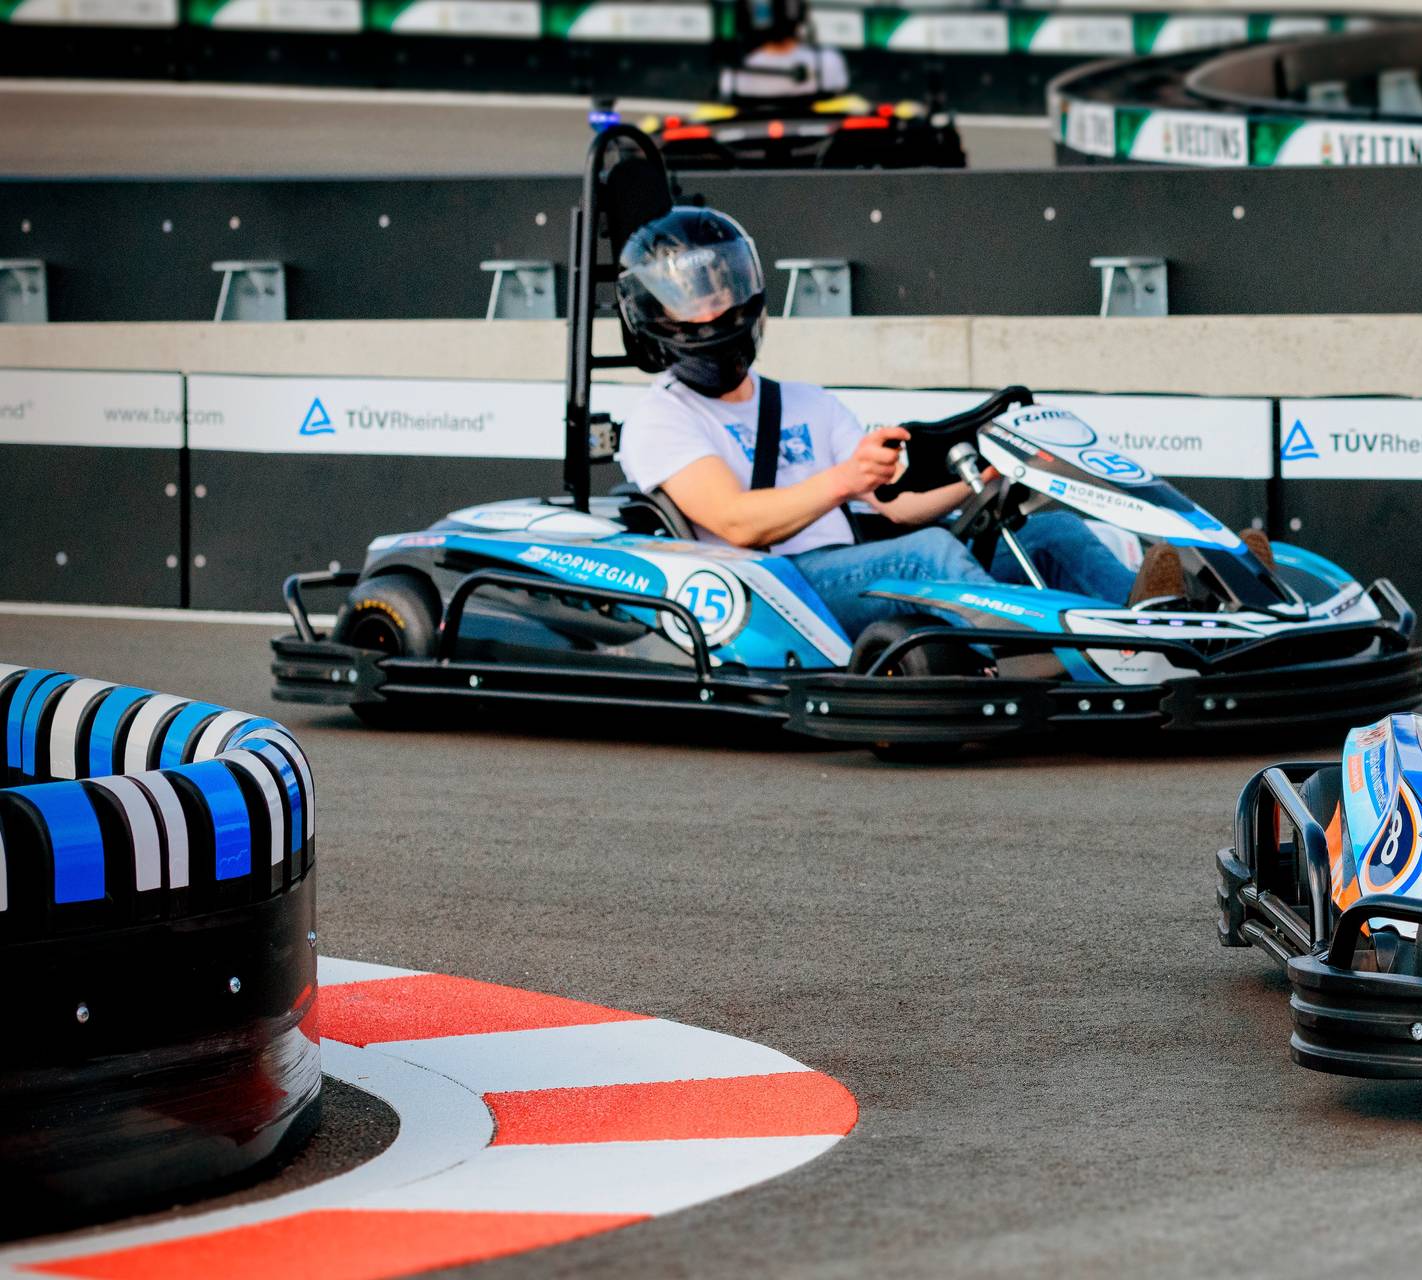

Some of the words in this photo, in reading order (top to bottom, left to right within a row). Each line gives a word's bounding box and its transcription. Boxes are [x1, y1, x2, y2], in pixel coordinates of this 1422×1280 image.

[1088, 454, 1138, 475] 15
[1068, 484, 1144, 512] NORWEGIAN
[548, 550, 650, 592] NORWEGIAN
[685, 586, 727, 623] 15
[1380, 810, 1403, 865] 8
